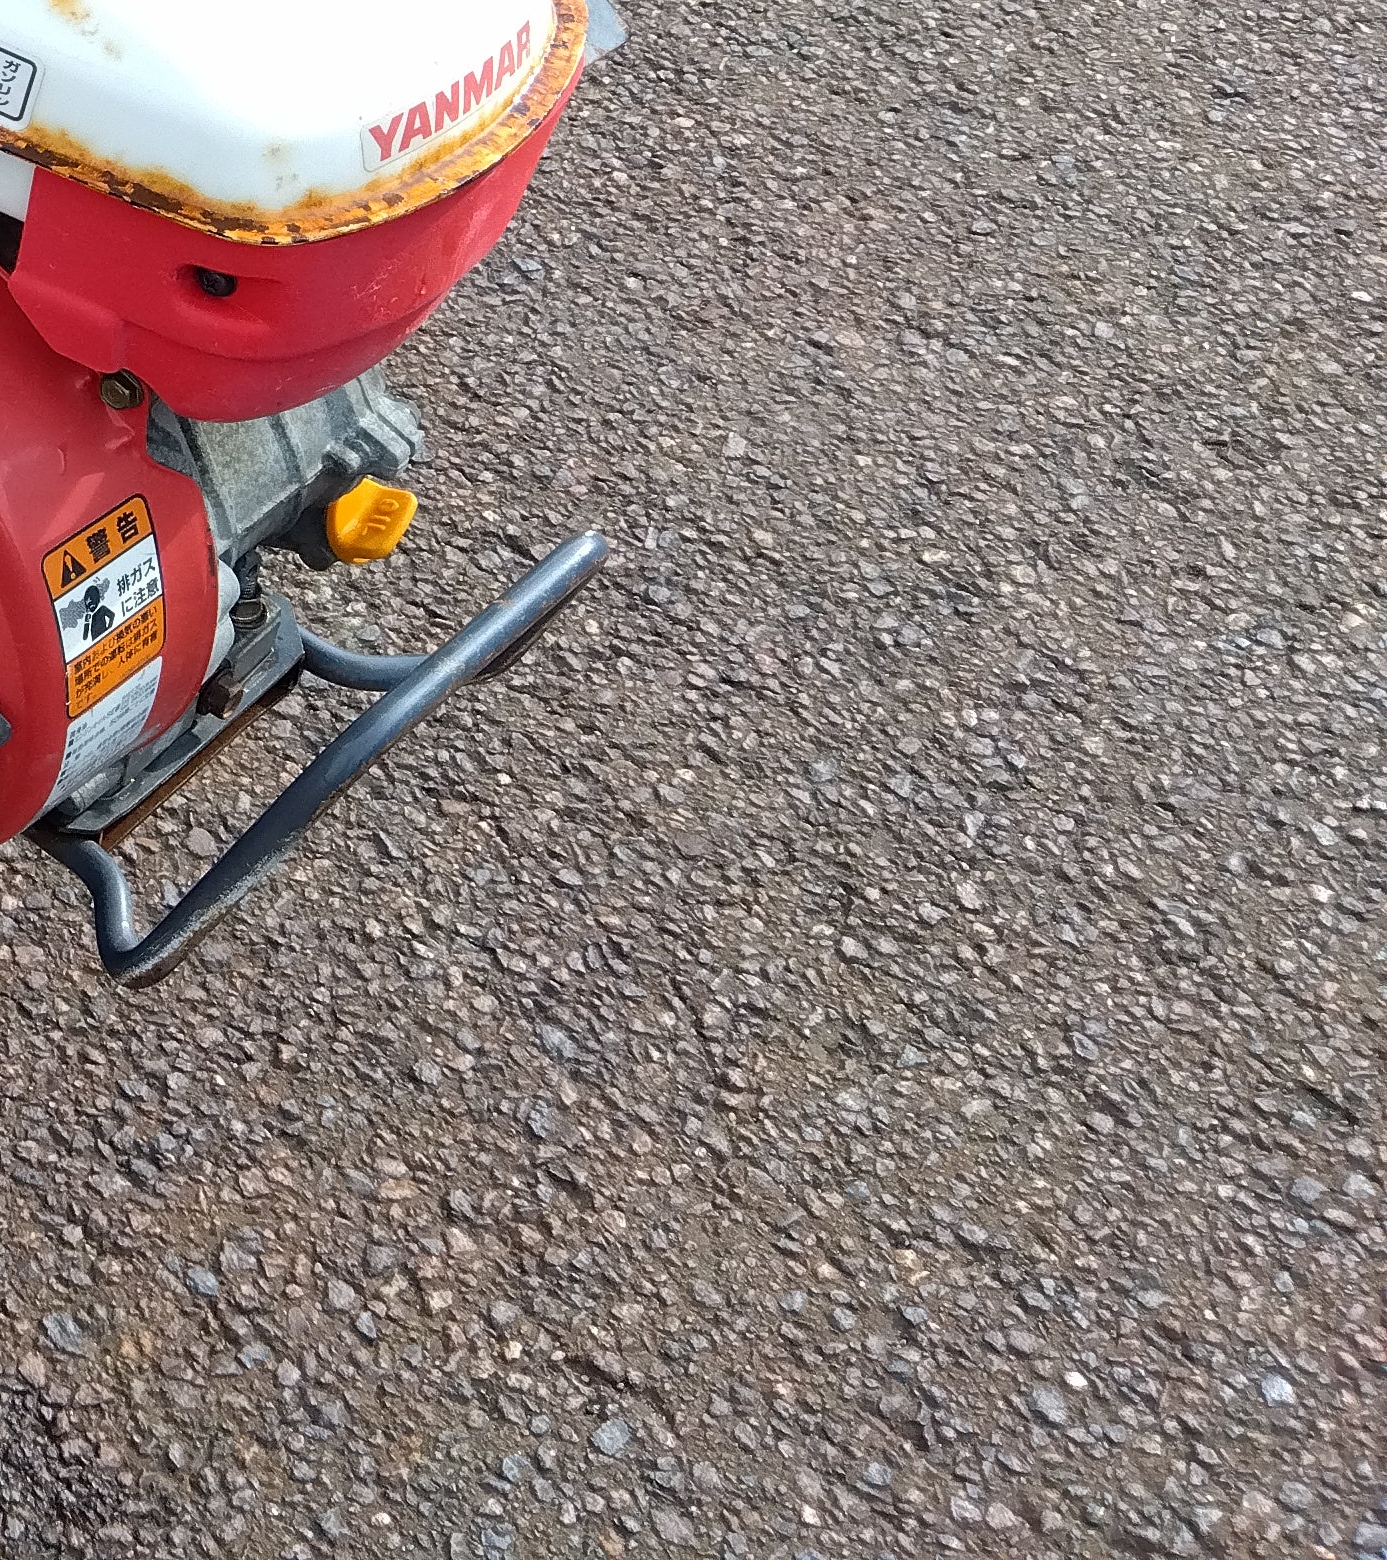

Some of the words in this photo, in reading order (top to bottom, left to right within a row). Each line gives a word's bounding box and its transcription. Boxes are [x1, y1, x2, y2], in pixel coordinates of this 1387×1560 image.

[368, 20, 531, 162] YANMAR
[85, 510, 139, 564] 警告
[116, 557, 156, 597] 排ガス
[120, 577, 160, 617] に注意
